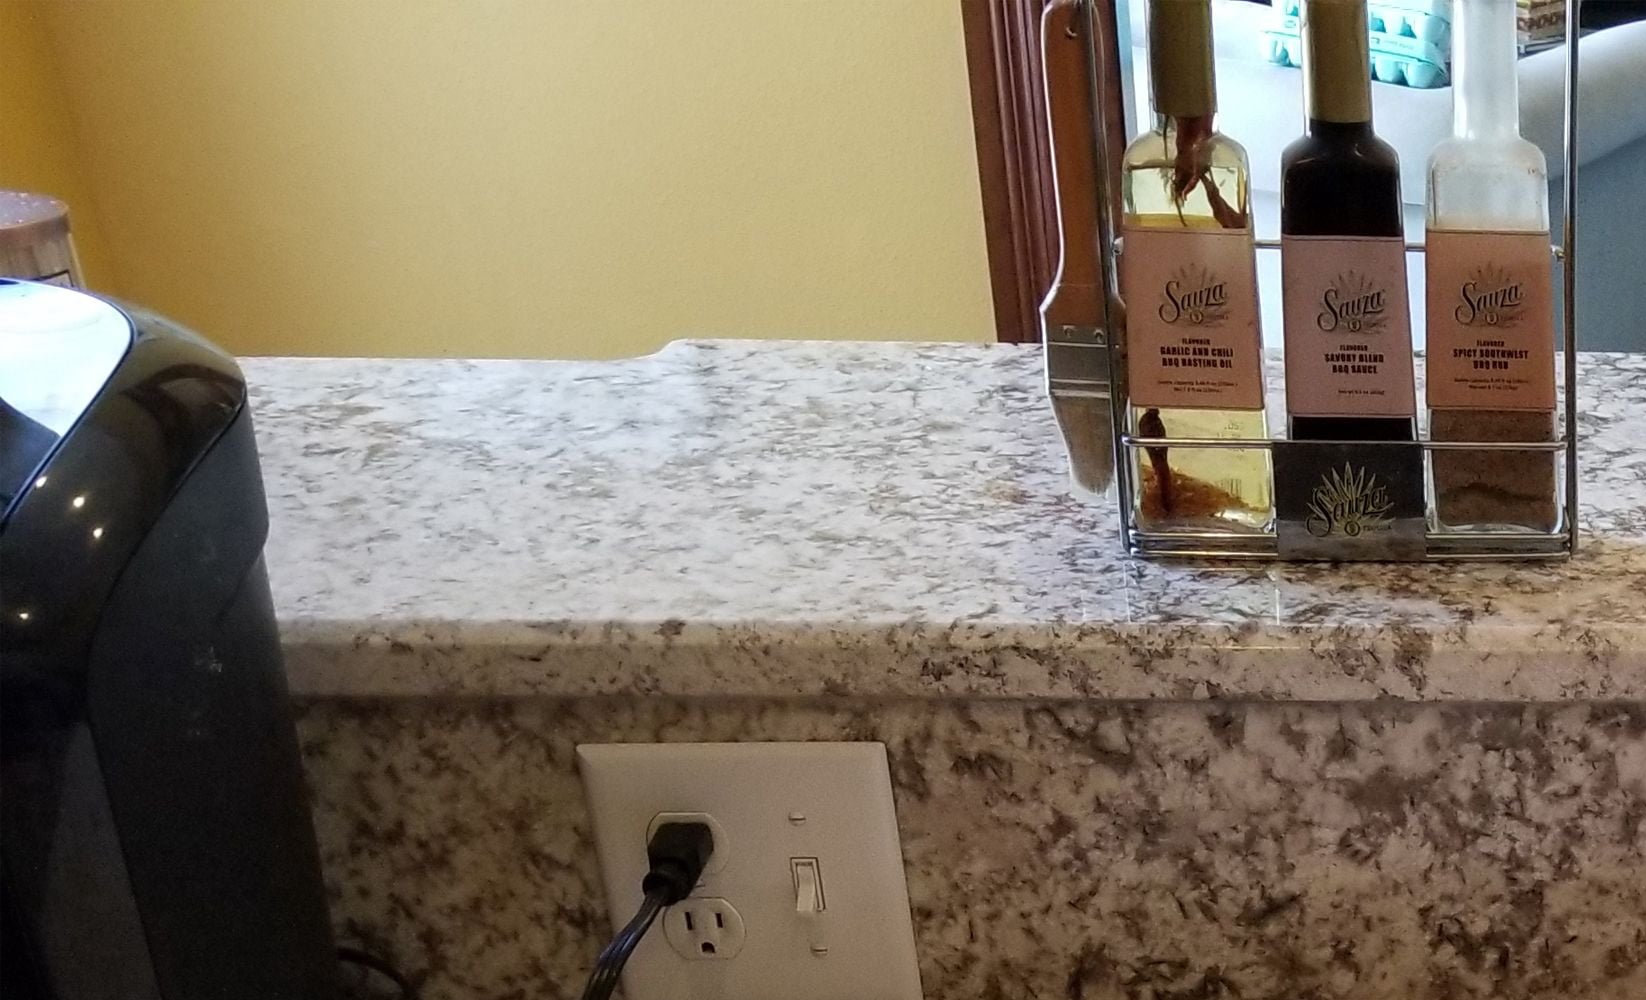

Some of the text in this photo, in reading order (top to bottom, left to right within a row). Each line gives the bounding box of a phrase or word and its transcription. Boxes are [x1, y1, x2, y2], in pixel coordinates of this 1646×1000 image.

[1158, 280, 1226, 324] Sauza
[1455, 282, 1522, 325] Sauza
[1316, 288, 1386, 332] Sauza
[1160, 346, 1234, 357] GARLIC AND CHILI
[1453, 348, 1529, 359] SPICY SOUTHWEST
[1162, 357, 1232, 369] BBQ BASTING OIL
[1324, 353, 1384, 363] SAVORY BLEND
[1332, 364, 1378, 374] BBQ SAUCE
[1492, 361, 1509, 370] RUB
[1305, 486, 1395, 537] Sauza
